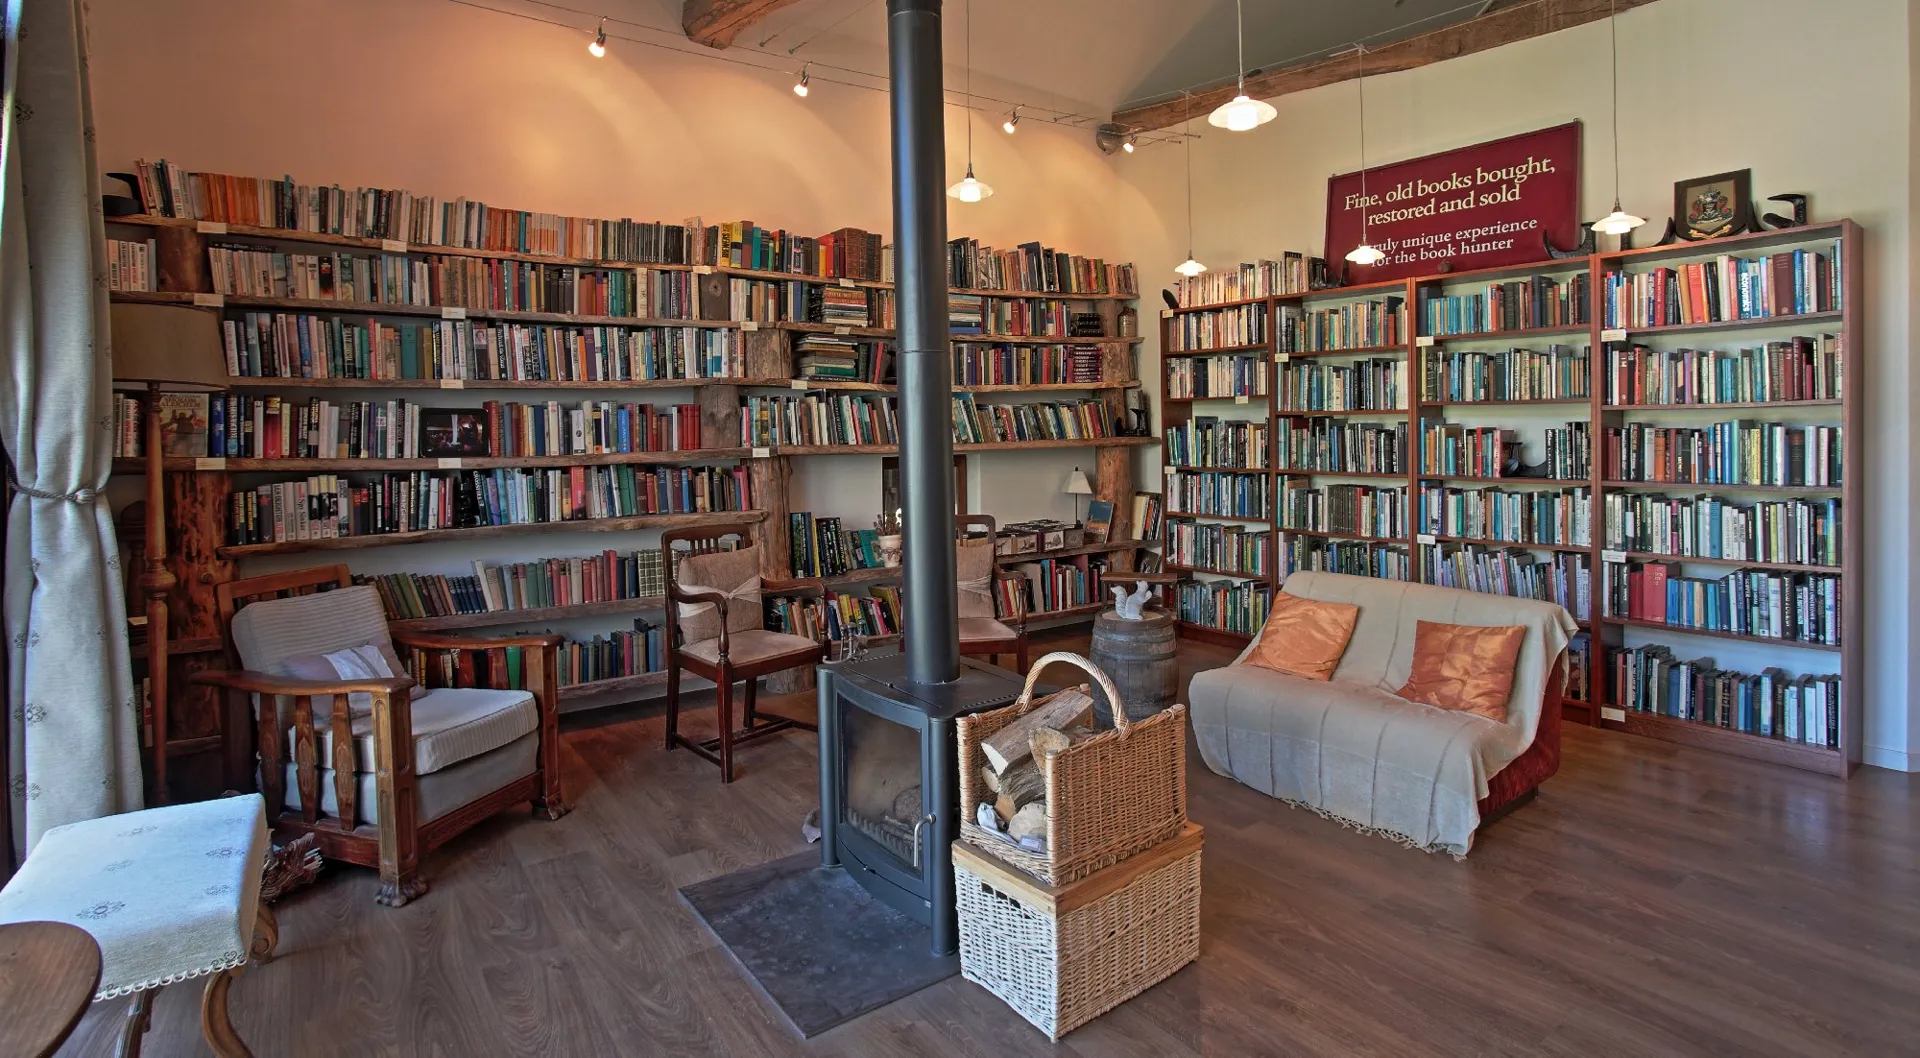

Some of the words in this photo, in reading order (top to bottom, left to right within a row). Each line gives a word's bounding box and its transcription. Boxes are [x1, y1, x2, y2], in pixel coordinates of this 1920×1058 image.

[1344, 194, 1382, 211] Fine,
[1386, 181, 1413, 203] old
[1417, 172, 1472, 196] books
[1476, 156, 1555, 183] bought,
[1368, 198, 1436, 226] restored
[1440, 190, 1476, 213] and
[1480, 184, 1522, 206] sold
[1395, 250, 1416, 264] the
[1420, 244, 1456, 260] book
[1460, 237, 1514, 256] hunter
[1402, 232, 1452, 249] unique
[1455, 218, 1538, 242] experience
